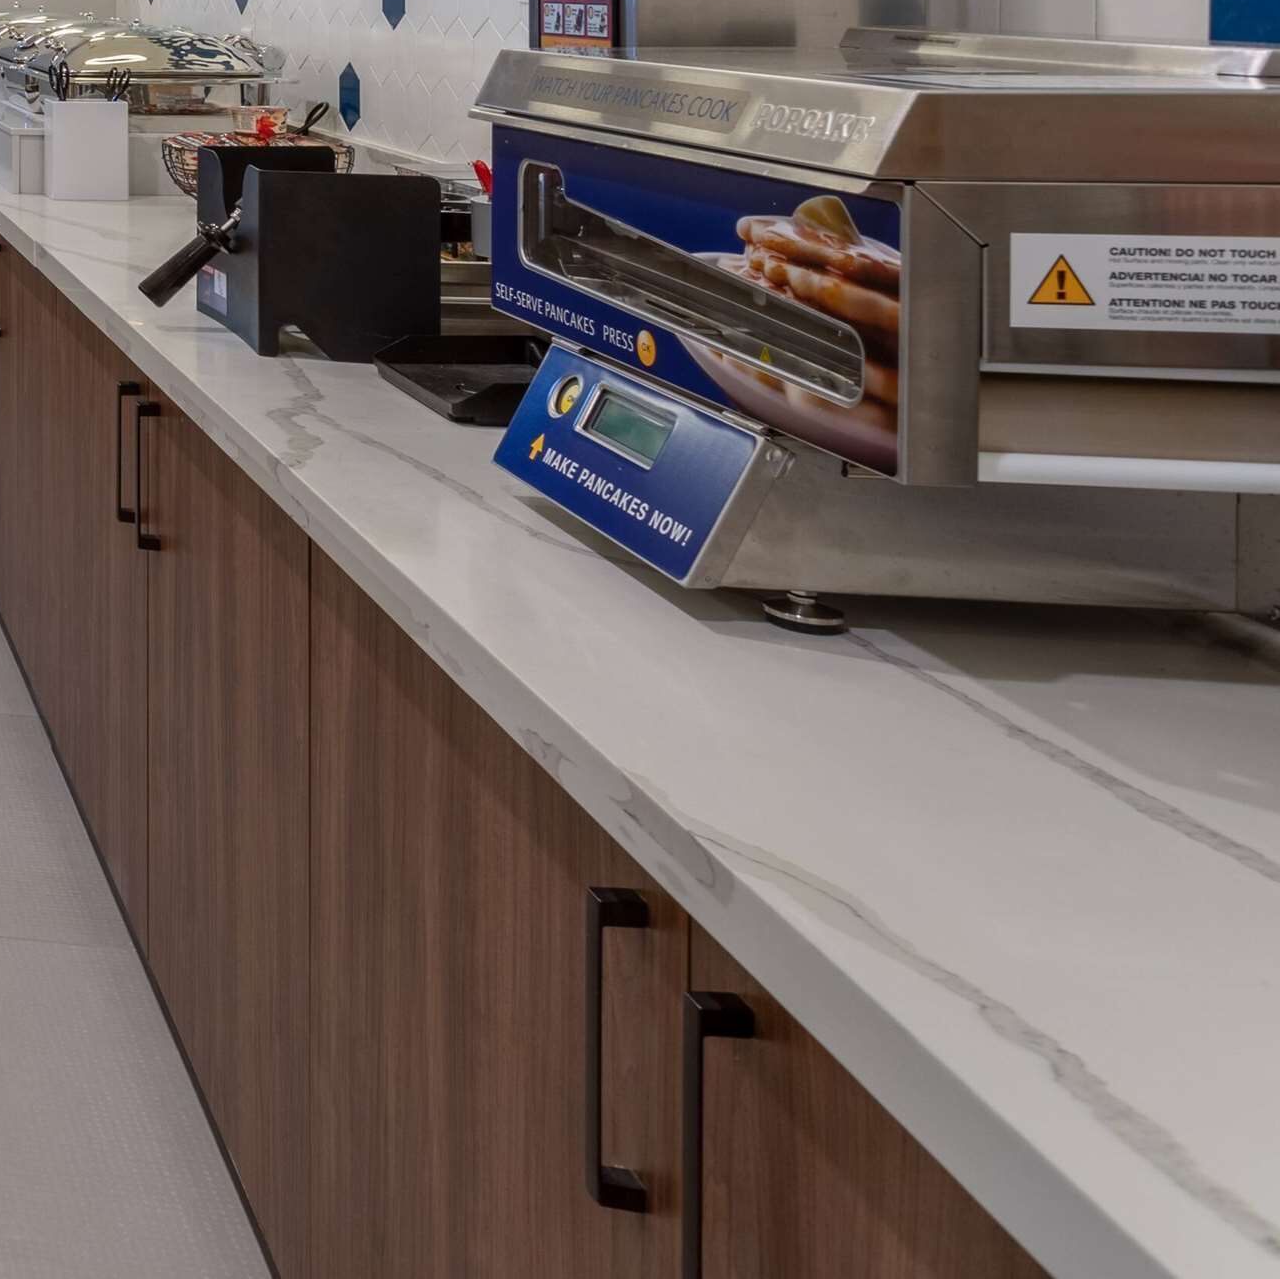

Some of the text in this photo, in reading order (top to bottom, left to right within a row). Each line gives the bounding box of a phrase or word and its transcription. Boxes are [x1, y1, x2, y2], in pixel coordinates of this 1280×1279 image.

[532, 76, 739, 122] WATCH YOUR PANCAKES COOK
[1109, 247, 1276, 259] CAUTION! DO NOT TOUCH
[1109, 271, 1277, 283] ADVERTENCIA! NO TOCAR
[495, 282, 543, 316] SELF-SERVE
[545, 301, 595, 336] PANCAKES
[602, 325, 634, 352] PRESS
[1109, 298, 1185, 308] ATTENTION!
[1189, 300, 1207, 309] NE
[1211, 300, 1236, 309] PAS
[542, 448, 693, 547] MAKE PANCAKES NOW!
